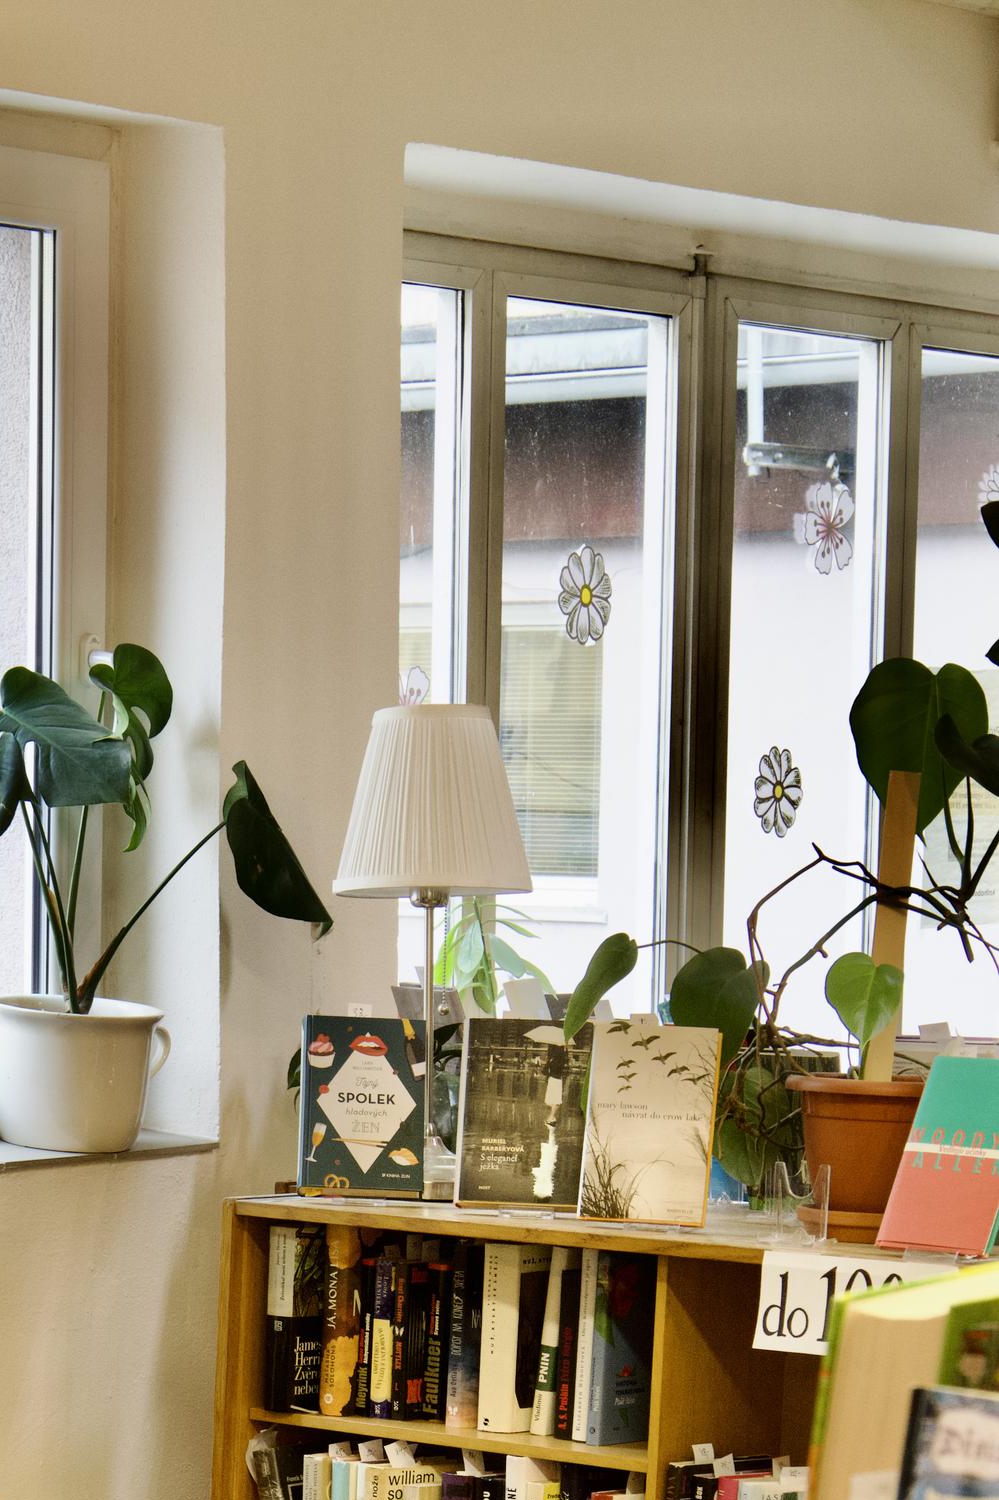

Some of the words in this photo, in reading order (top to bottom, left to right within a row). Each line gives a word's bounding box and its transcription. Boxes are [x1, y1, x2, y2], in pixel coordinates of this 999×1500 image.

[337, 1092, 395, 1105] SPOLEK
[597, 1102, 617, 1110] mary
[619, 1101, 648, 1110] lawson
[345, 1109, 388, 1117] hladových
[622, 1111, 648, 1119] návrat
[650, 1111, 661, 1119] do
[351, 1120, 380, 1133] ŽEN
[487, 1154, 518, 1164] elegancí
[329, 1271, 338, 1309] MONA
[762, 1271, 809, 1338] do
[422, 1336, 440, 1413] Faulkner
[538, 1352, 550, 1383] PNIN
[355, 1366, 369, 1409] Meyrink
[388, 1471, 435, 1486] william
